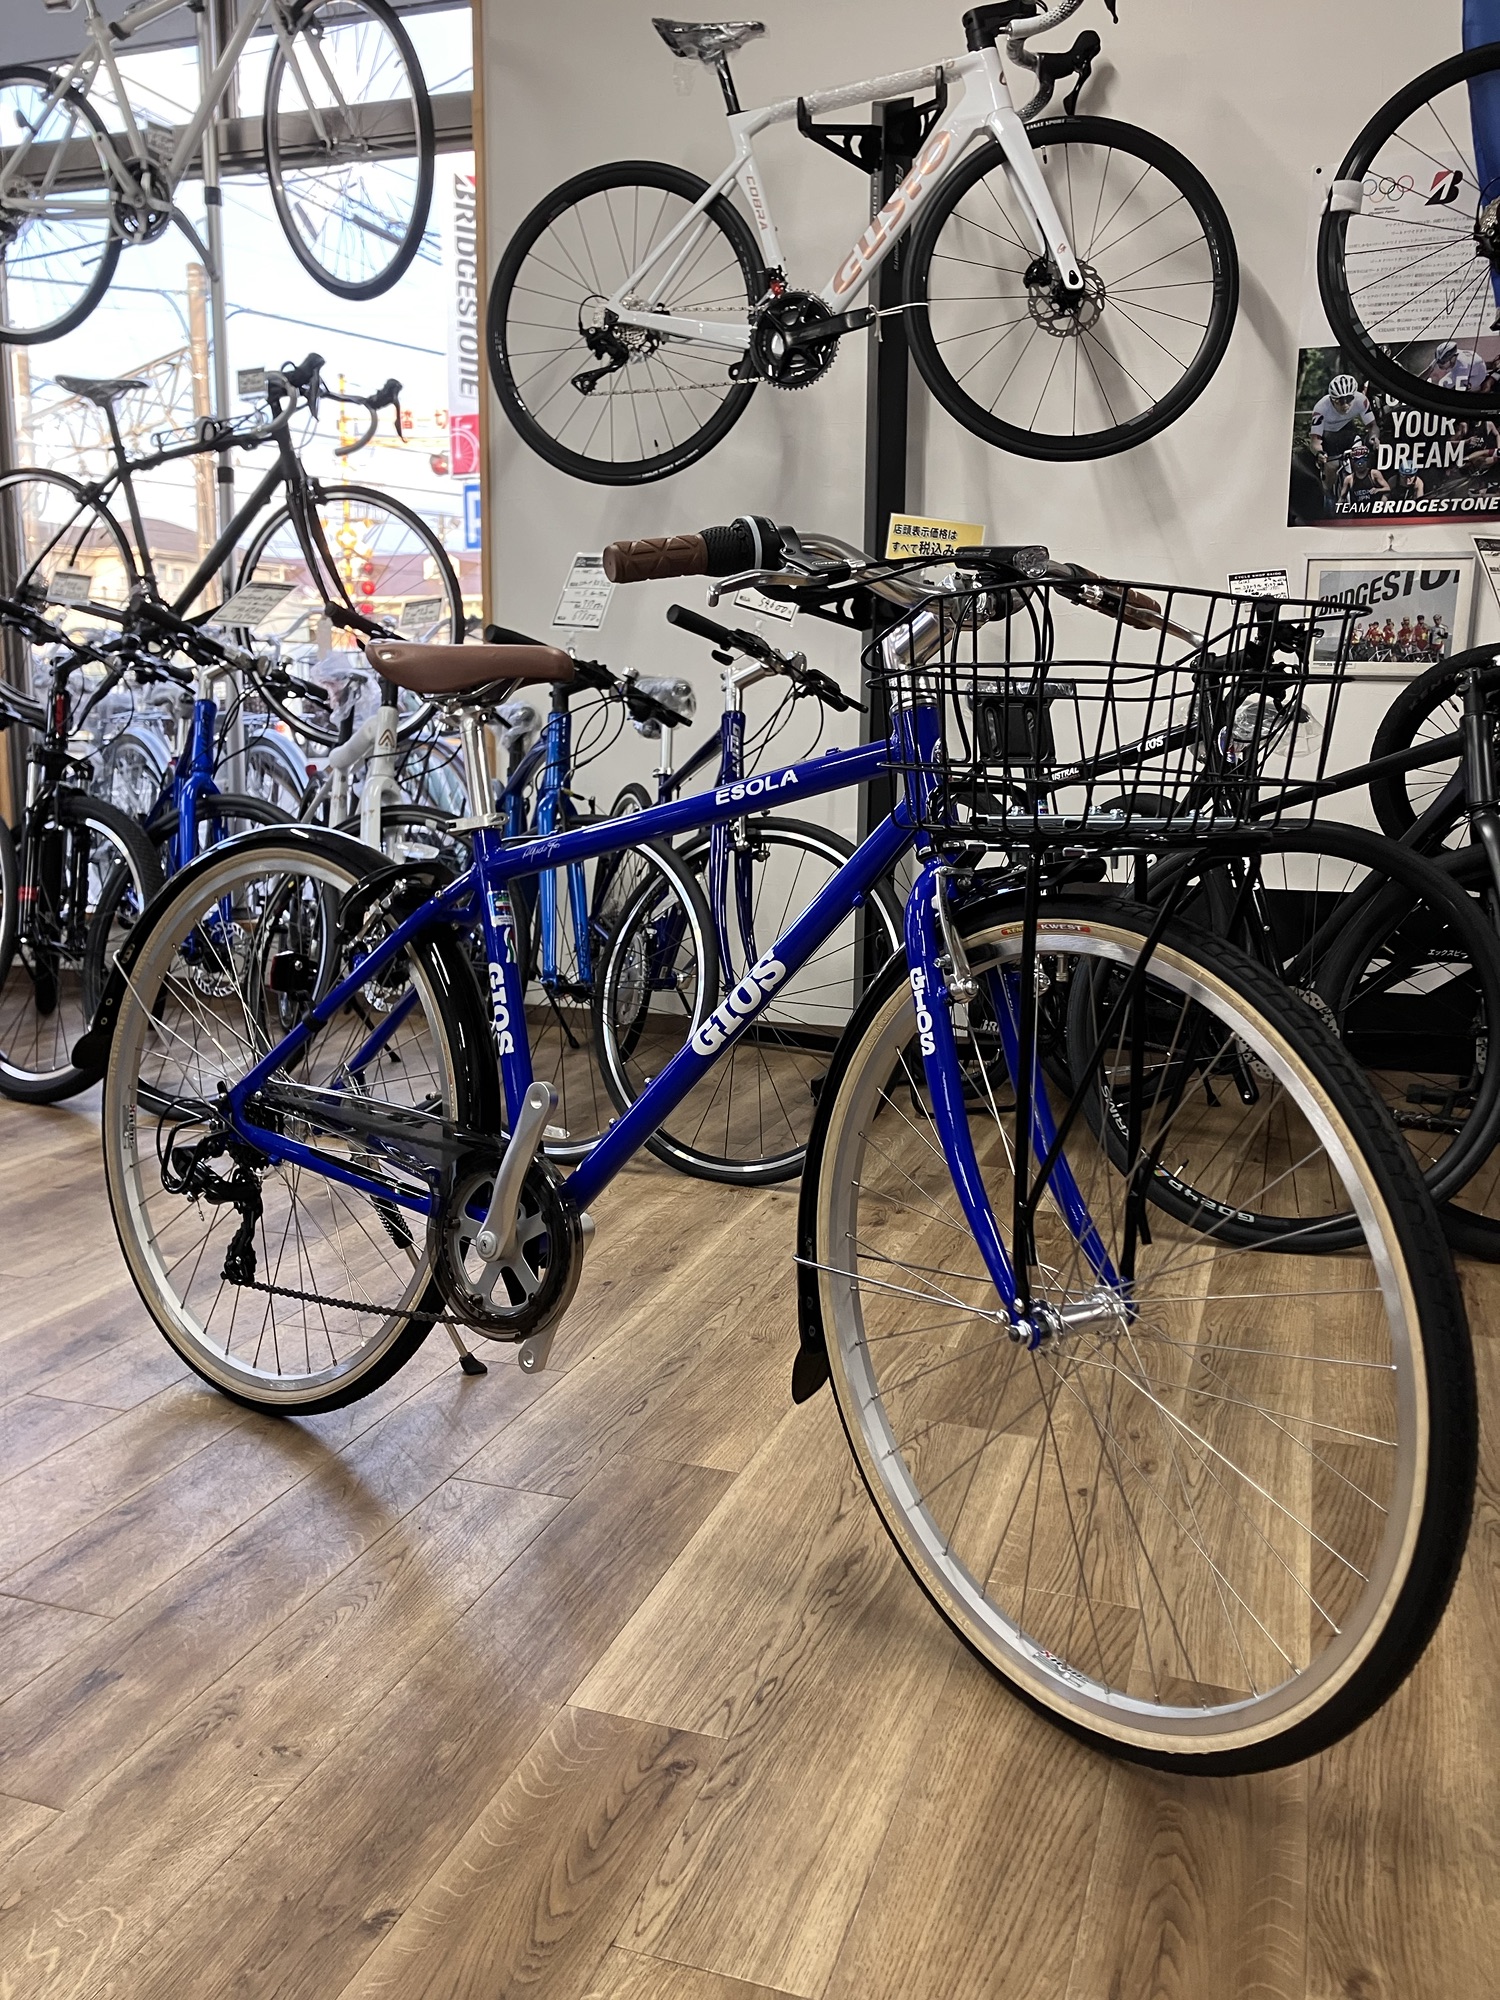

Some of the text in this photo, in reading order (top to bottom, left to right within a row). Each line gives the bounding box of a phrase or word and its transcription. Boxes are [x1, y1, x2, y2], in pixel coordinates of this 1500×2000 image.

[746, 176, 768, 230] COBRA
[1391, 410, 1456, 438] YOUR
[1377, 441, 1465, 471] DREAM
[1335, 497, 1499, 514] TEAM BRIDGESTONE
[893, 524, 957, 540] 店頭表示価格は
[716, 769, 798, 805] ESOLA
[1040, 923, 1083, 931] KWEST
[488, 963, 514, 1056] GIOS
[691, 949, 786, 1056] GIOS
[910, 966, 936, 1056] GIOS
